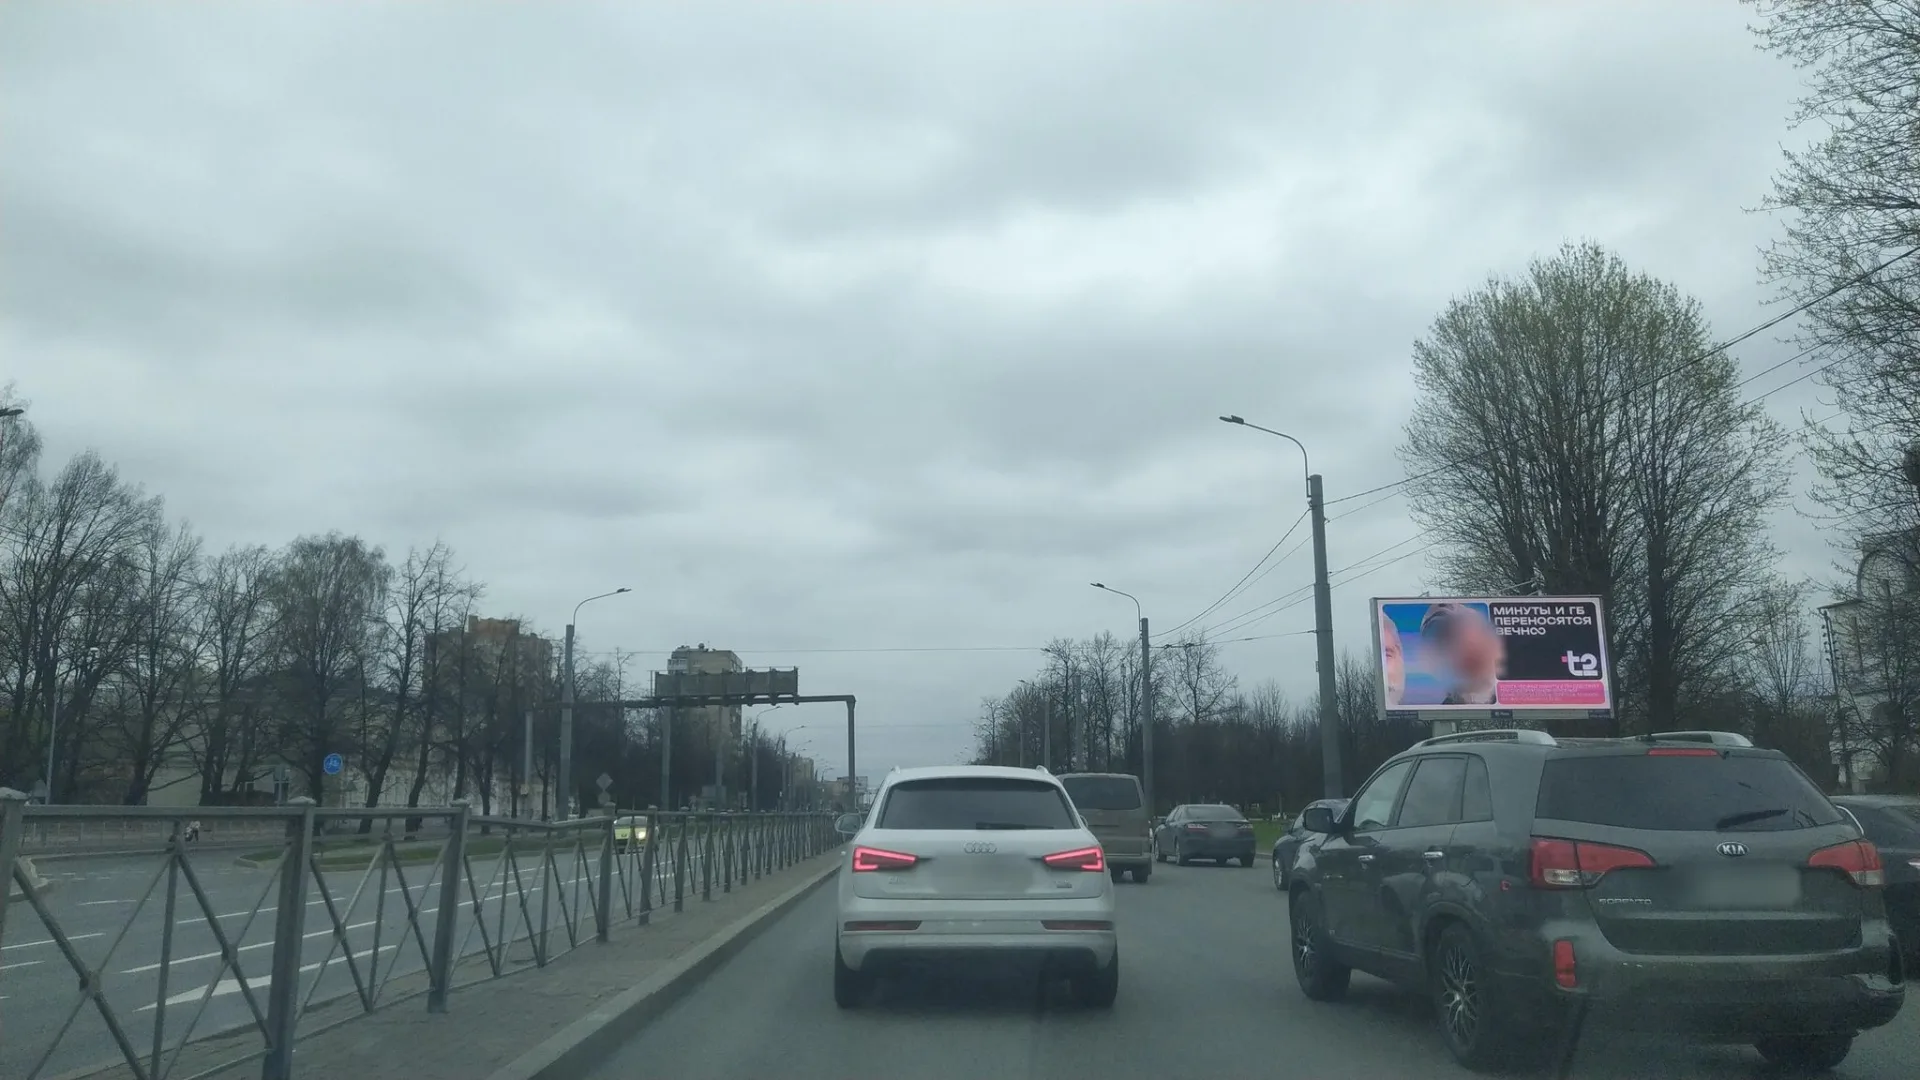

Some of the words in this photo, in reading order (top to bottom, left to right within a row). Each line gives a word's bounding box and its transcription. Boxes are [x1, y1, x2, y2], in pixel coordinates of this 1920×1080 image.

[1493, 606, 1551, 615] МИНУТЫ
[1555, 606, 1564, 615] И
[1569, 606, 1585, 615] ГБ
[1494, 616, 1592, 625] ПЕРЕНОСЯТСЯ
[1562, 650, 1599, 676] t2
[1722, 844, 1746, 855] KIA
